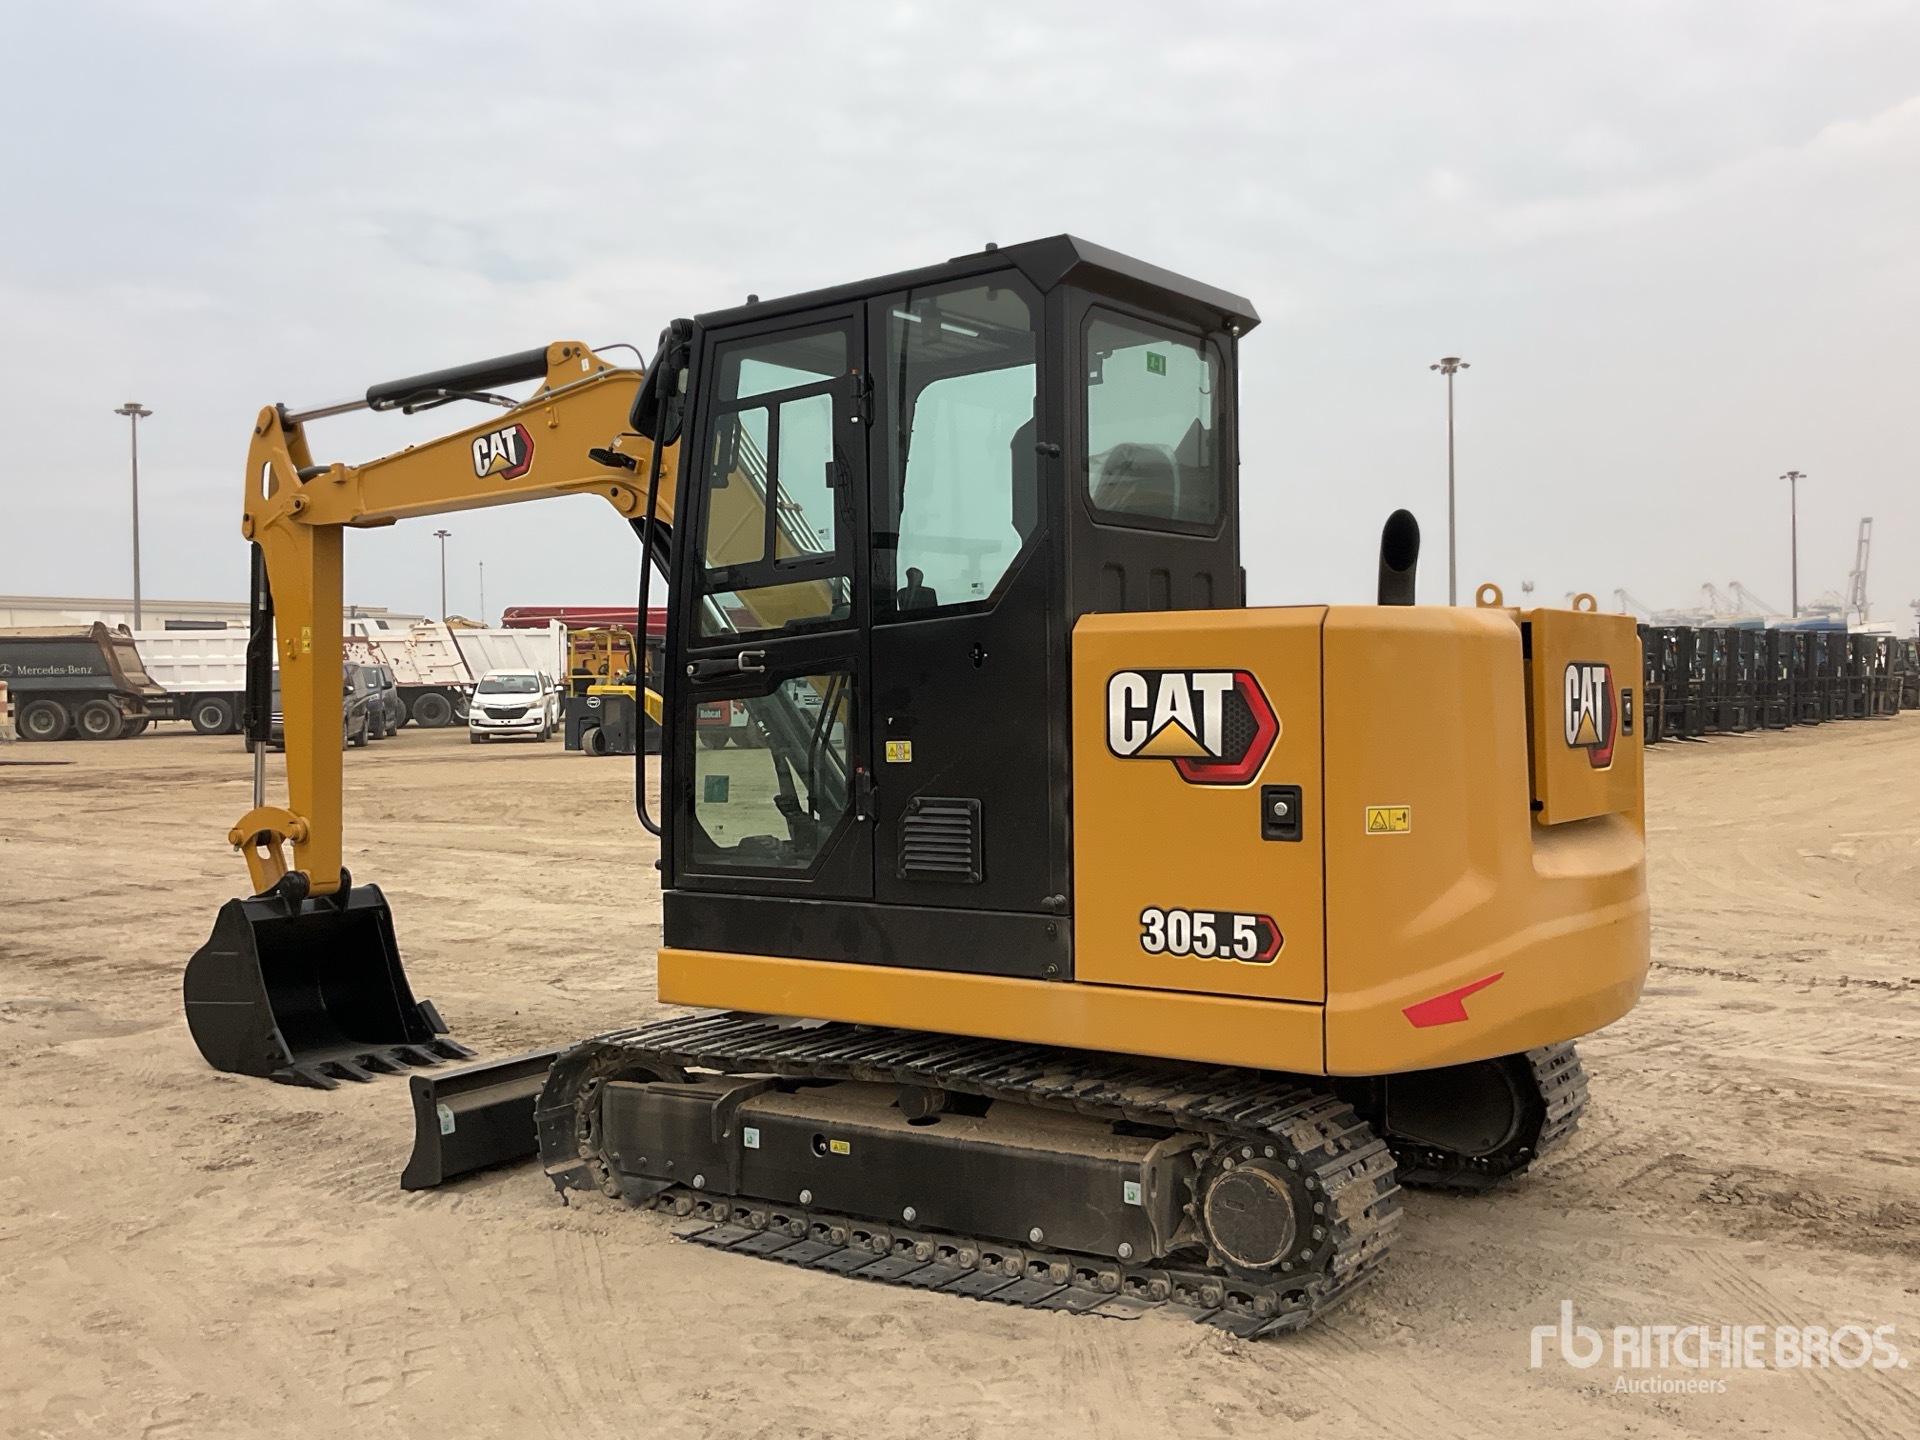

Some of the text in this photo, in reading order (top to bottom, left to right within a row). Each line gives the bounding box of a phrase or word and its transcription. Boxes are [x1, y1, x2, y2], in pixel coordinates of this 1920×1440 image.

[472, 426, 517, 477] CAT
[17, 665, 93, 675] Mercedes-Benz
[700, 709, 721, 718] Bobcat
[1108, 671, 1234, 757] CAT
[1565, 664, 1605, 745] CAT
[1141, 908, 1258, 959] 305.5
